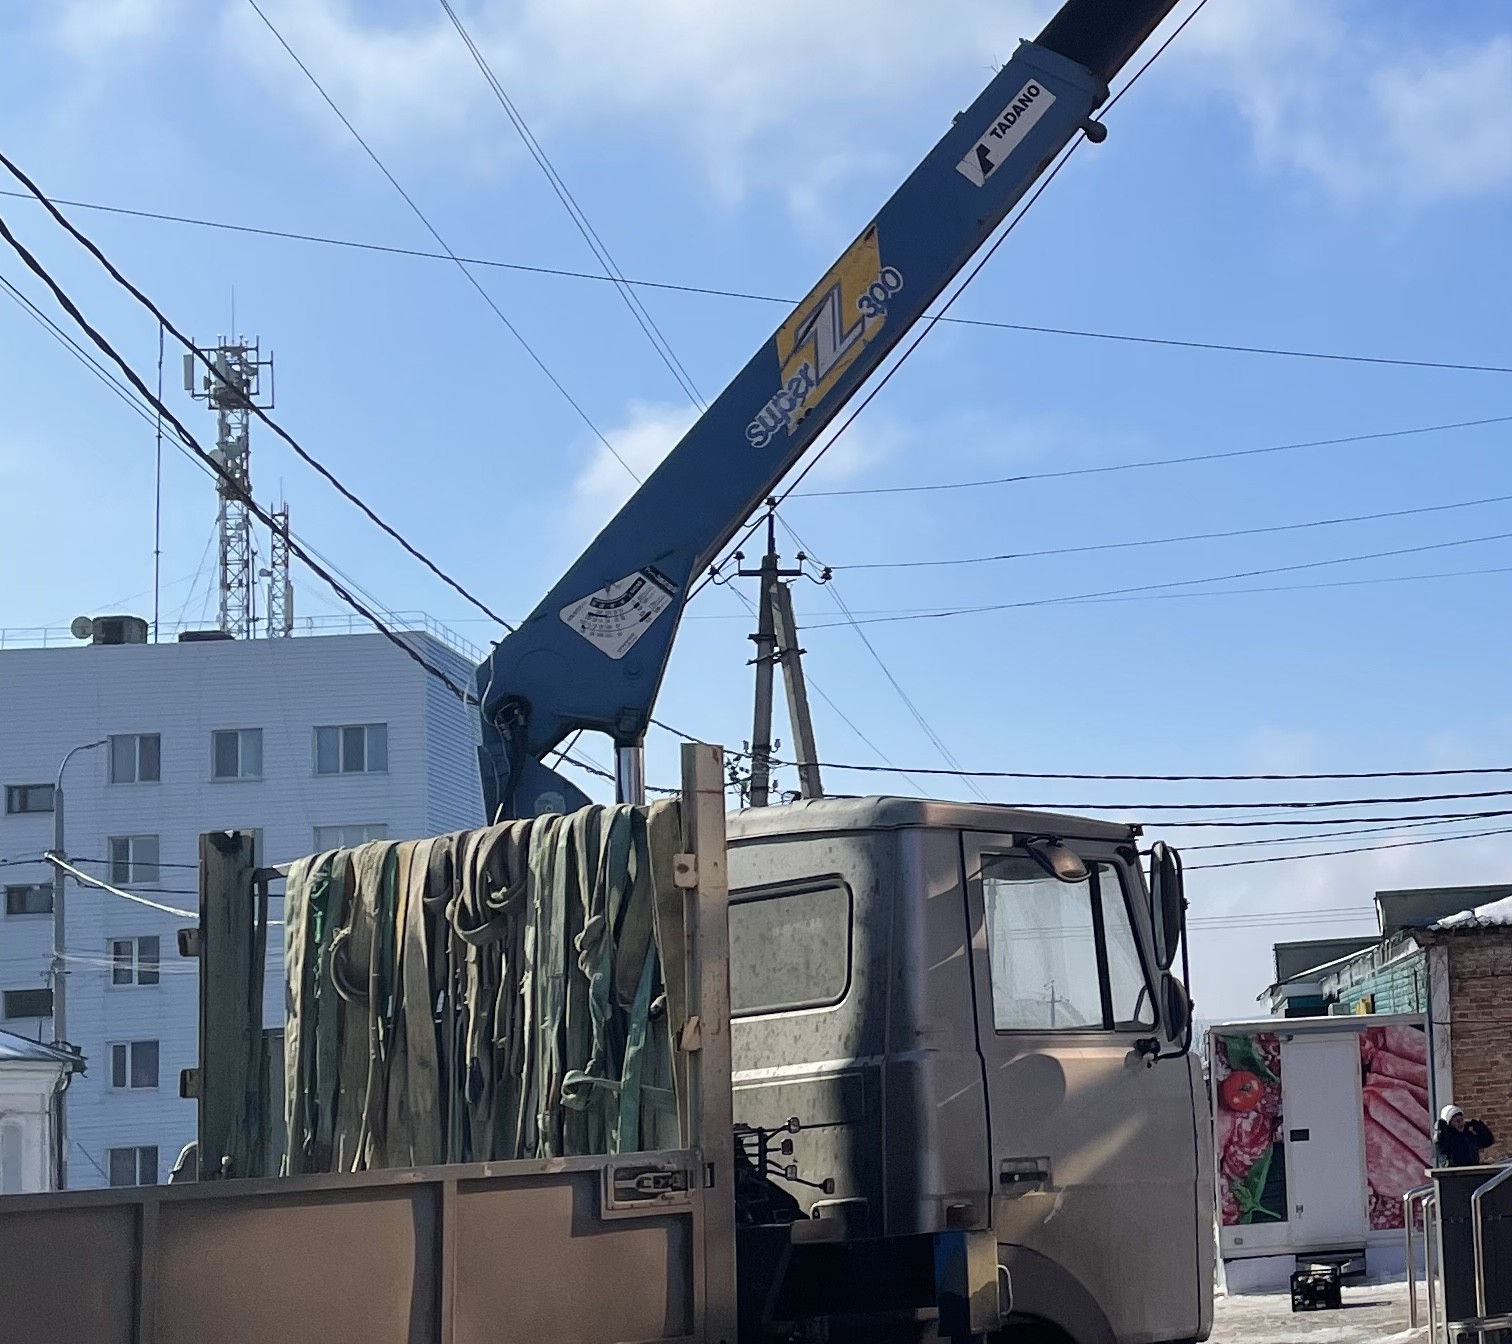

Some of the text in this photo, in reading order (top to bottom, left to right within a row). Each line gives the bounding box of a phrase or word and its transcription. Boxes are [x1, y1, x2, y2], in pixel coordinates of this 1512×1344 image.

[989, 84, 1041, 140] TADANO
[746, 360, 816, 447] super
[857, 266, 904, 320] 300
